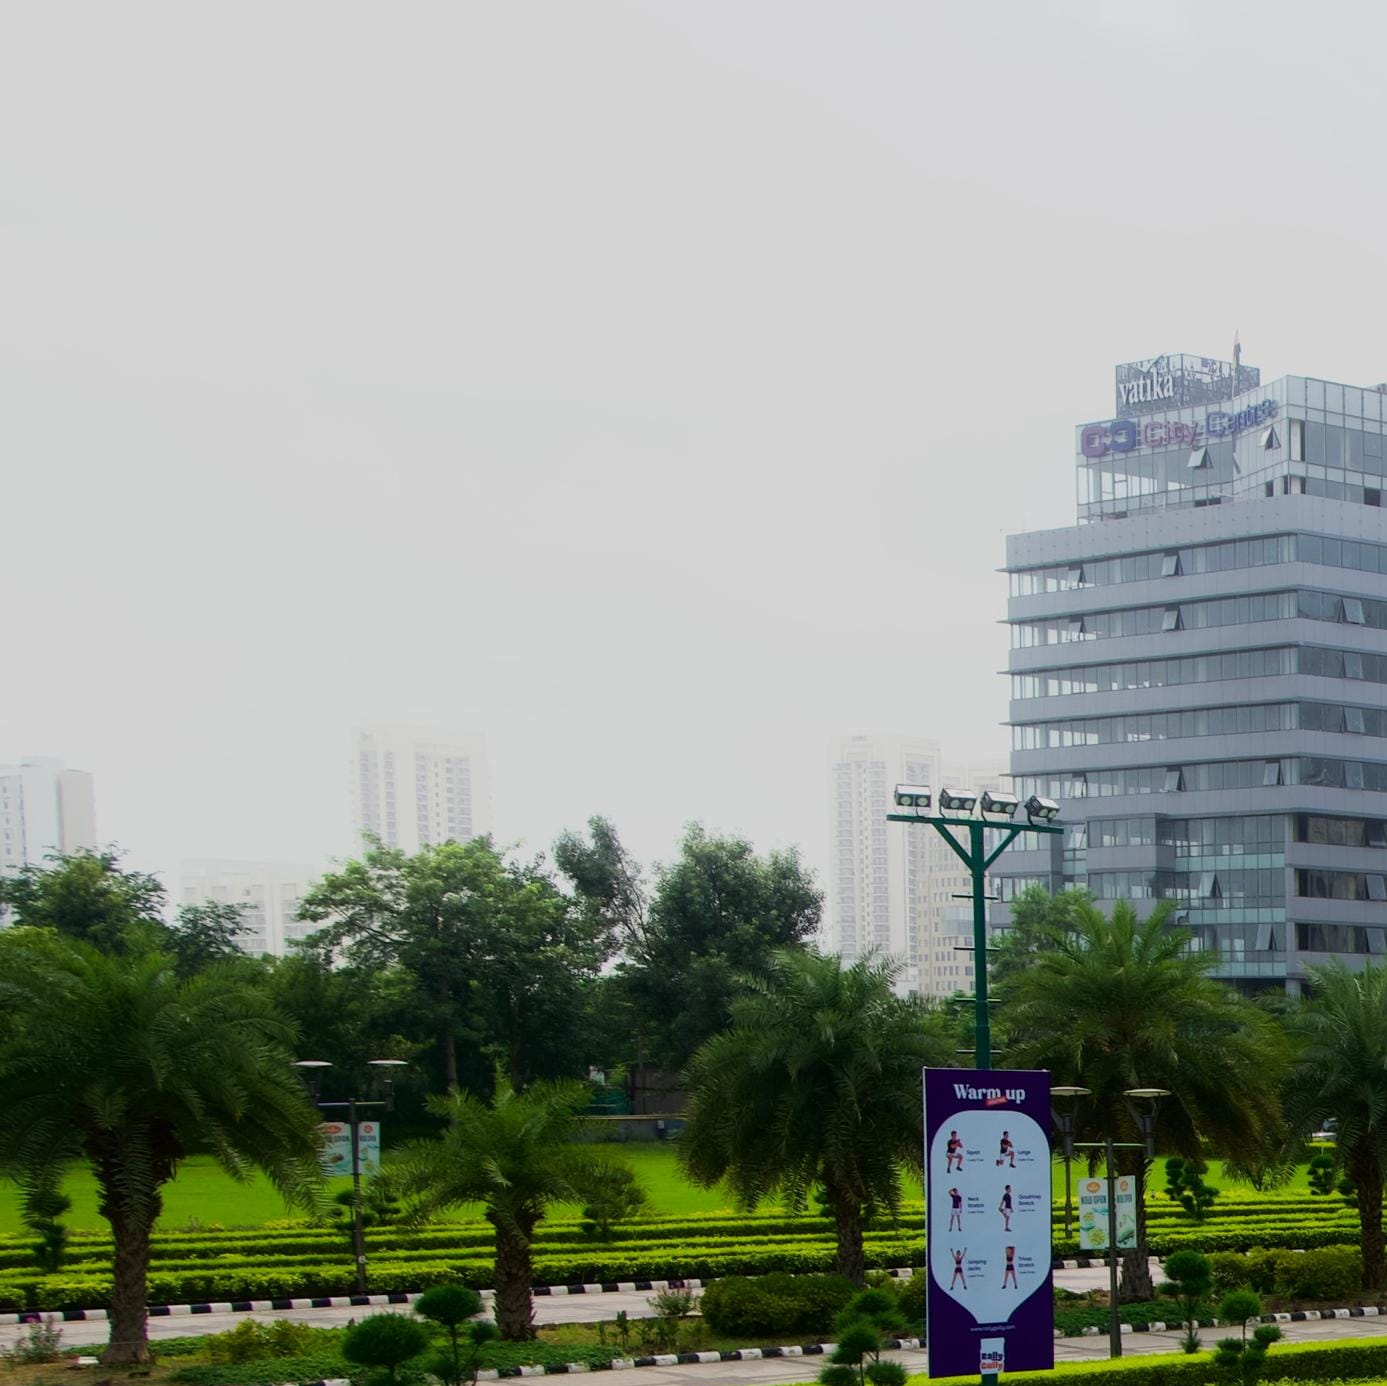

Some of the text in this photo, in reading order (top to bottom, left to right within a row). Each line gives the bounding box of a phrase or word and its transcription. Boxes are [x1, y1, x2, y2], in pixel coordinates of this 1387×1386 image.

[1142, 420, 1199, 448] City
[954, 1084, 1002, 1100] Warm
[1005, 1088, 1026, 1104] up
